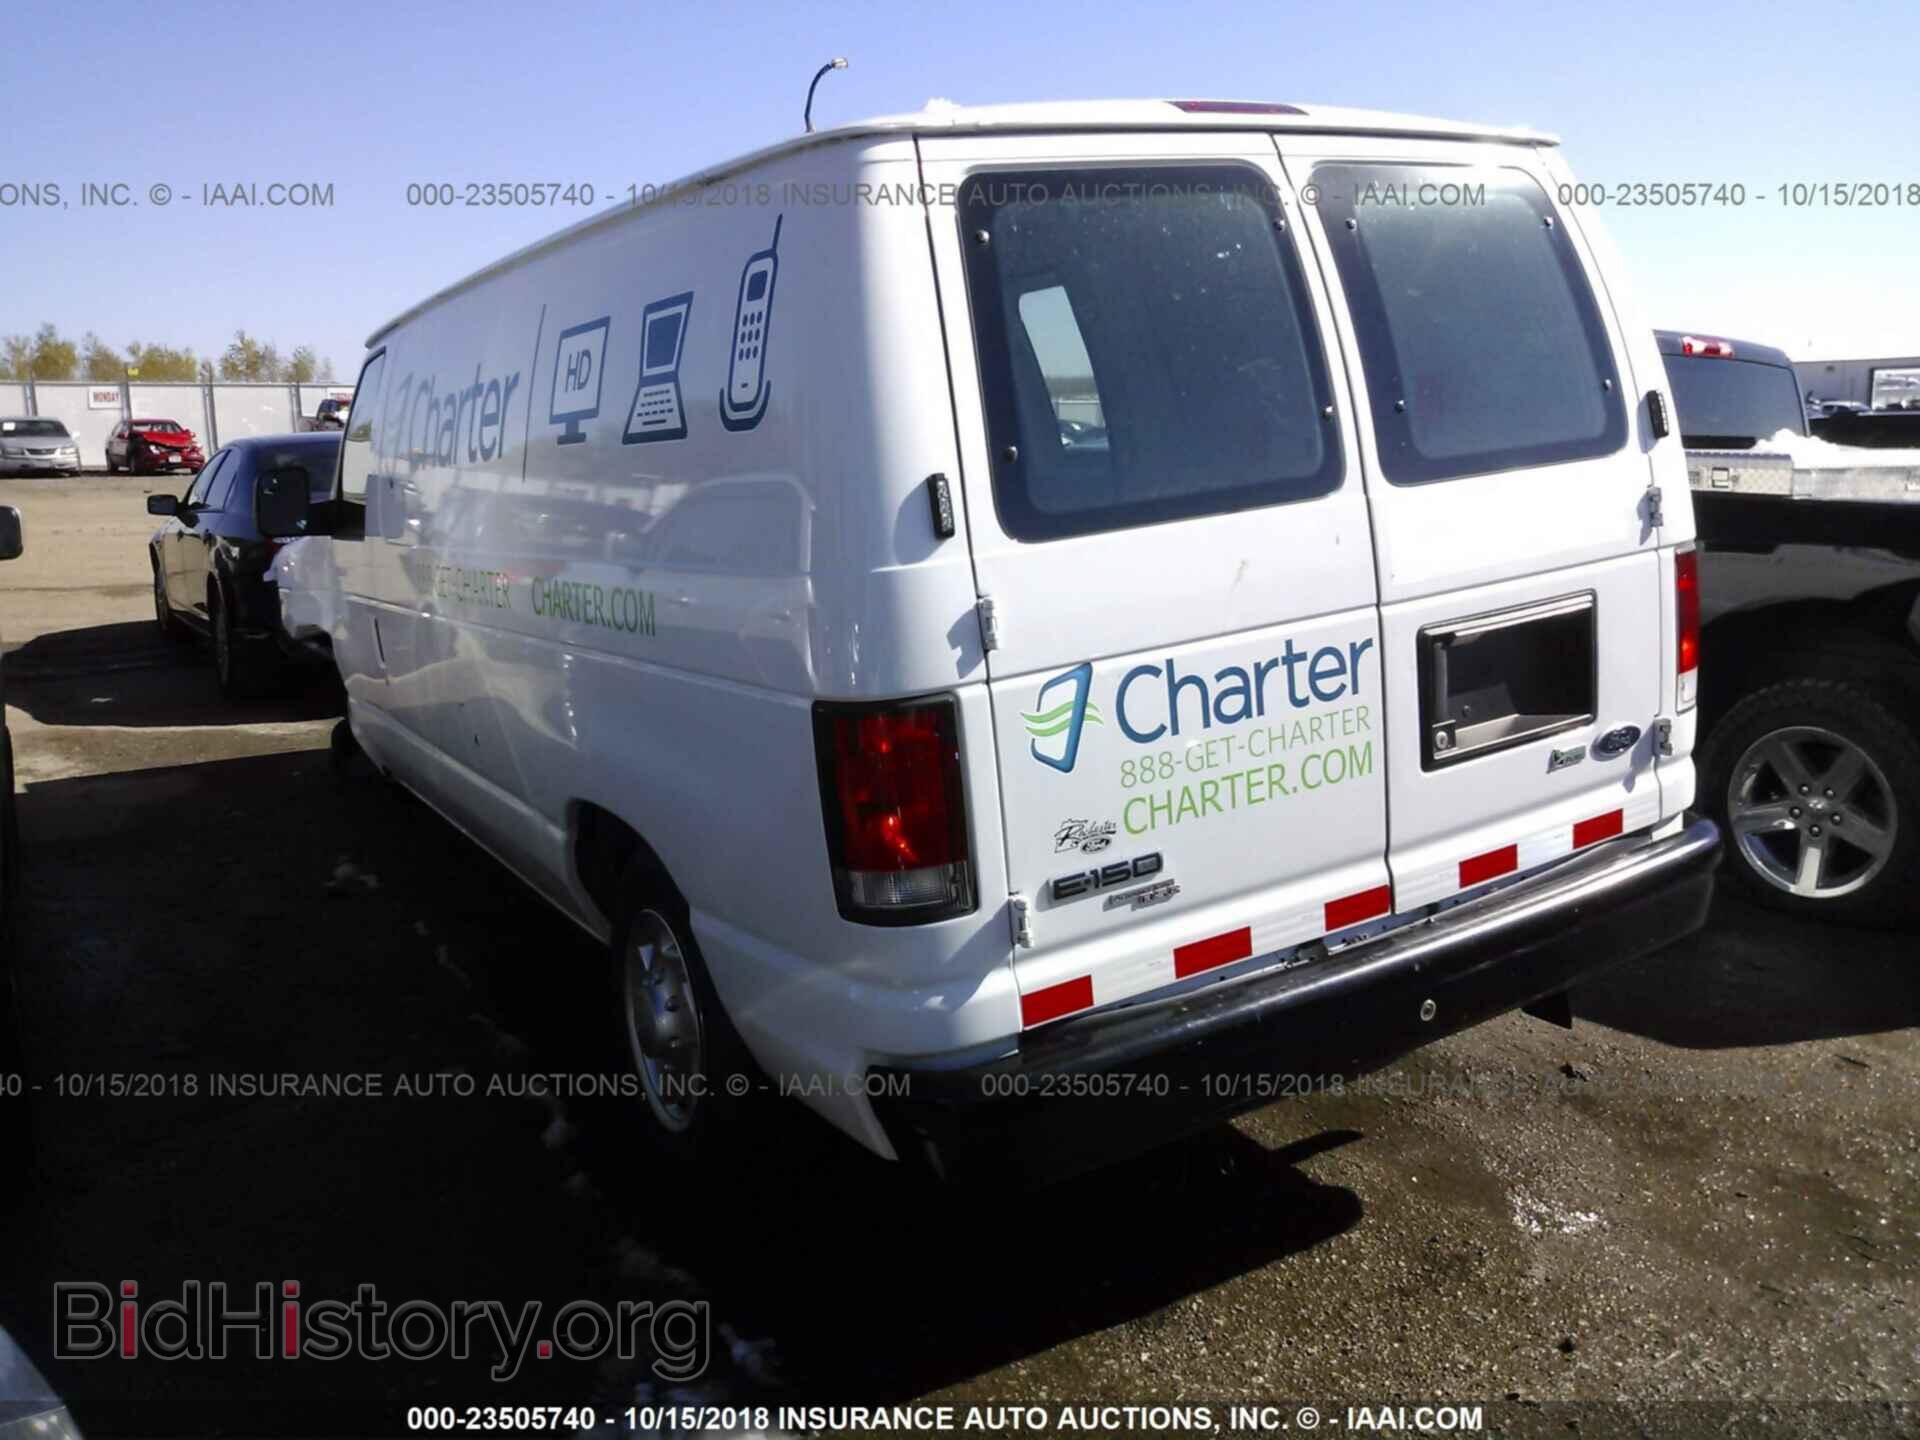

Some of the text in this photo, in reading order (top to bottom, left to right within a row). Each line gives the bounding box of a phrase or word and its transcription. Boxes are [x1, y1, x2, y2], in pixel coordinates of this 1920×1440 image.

[410, 362, 520, 469] Charter
[564, 349, 593, 393] HD
[531, 577, 656, 637] CHARTER.COM
[1116, 637, 1374, 744] Charter
[1120, 705, 1372, 788] 888-GET-CHARTER
[1123, 740, 1373, 835] CHARTER.COM
